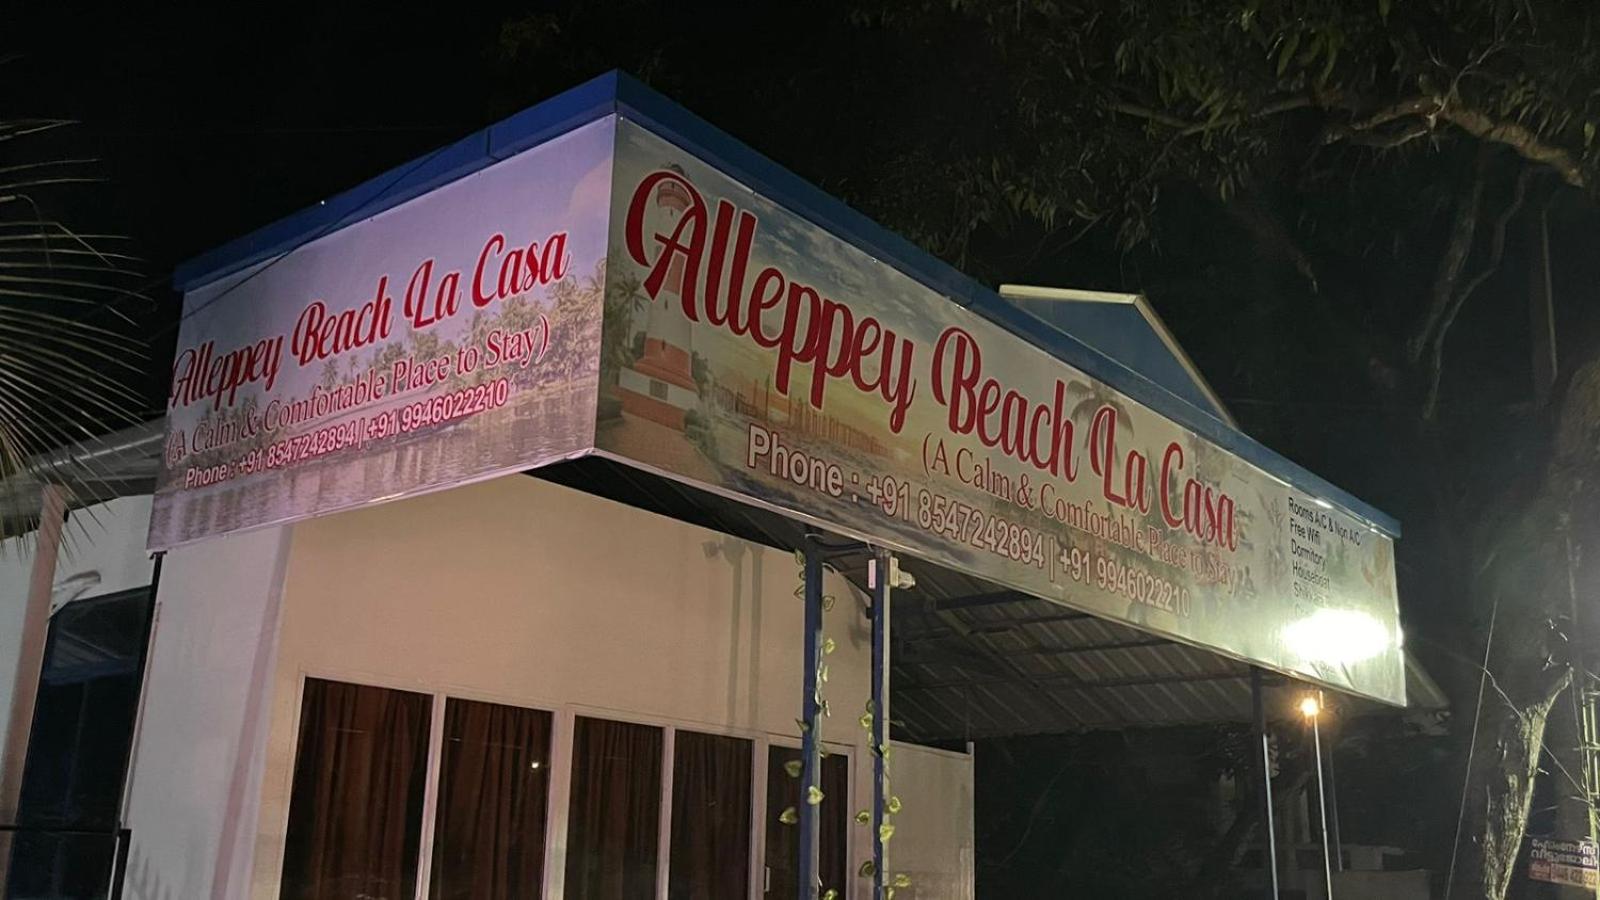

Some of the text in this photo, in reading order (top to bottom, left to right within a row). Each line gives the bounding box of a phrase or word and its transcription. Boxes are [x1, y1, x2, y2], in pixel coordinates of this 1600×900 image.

[171, 231, 571, 411] Alleppey Beach La Casa
[192, 417, 237, 455] Calm
[241, 405, 259, 440] &
[263, 365, 386, 432] Comfortable
[391, 354, 450, 397] Place
[456, 346, 480, 376] to
[485, 314, 550, 369] Stay)
[625, 169, 1239, 552] Alleppey Beach La Casa
[185, 463, 231, 491] Phone
[239, 448, 263, 476] +91
[266, 419, 357, 471] 8547242894
[368, 408, 399, 440] +91
[400, 376, 509, 433] 9946022210
[922, 432, 951, 477] (A
[956, 447, 1012, 501] Calm
[1016, 473, 1036, 509] &
[1040, 483, 1144, 551] Comfortable
[1148, 525, 1187, 569] Place
[747, 422, 844, 498] Phone
[866, 473, 910, 522] +91
[917, 488, 1046, 569] 8547242894
[1060, 547, 1091, 585] +91
[1096, 556, 1191, 618] 9946022210
[1288, 496, 1314, 523] Rooms
[1290, 517, 1306, 539] Free
